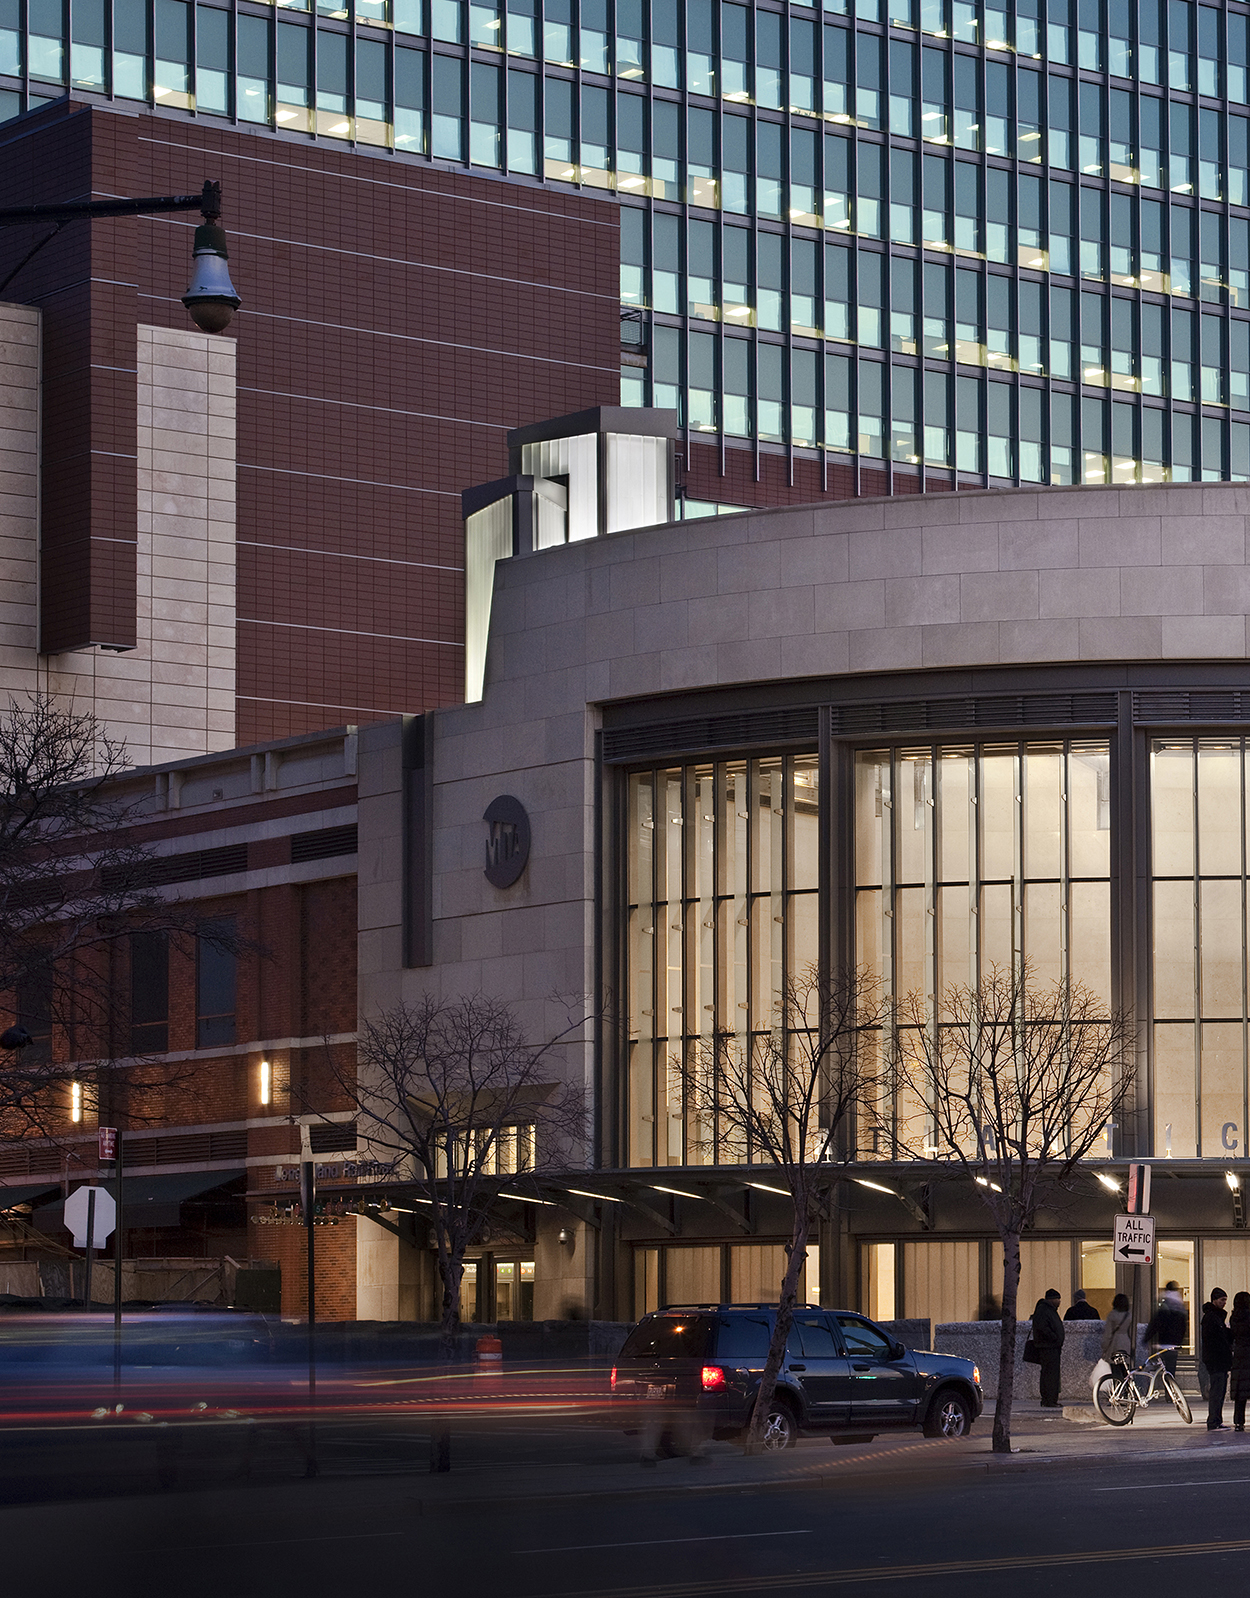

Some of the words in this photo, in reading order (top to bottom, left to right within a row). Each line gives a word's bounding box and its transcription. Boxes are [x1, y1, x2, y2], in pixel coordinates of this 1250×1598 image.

[813, 1121, 1238, 1154] ATLATIC
[1125, 1219, 1143, 1230] ALL
[1117, 1231, 1151, 1244] TRAFFIC
